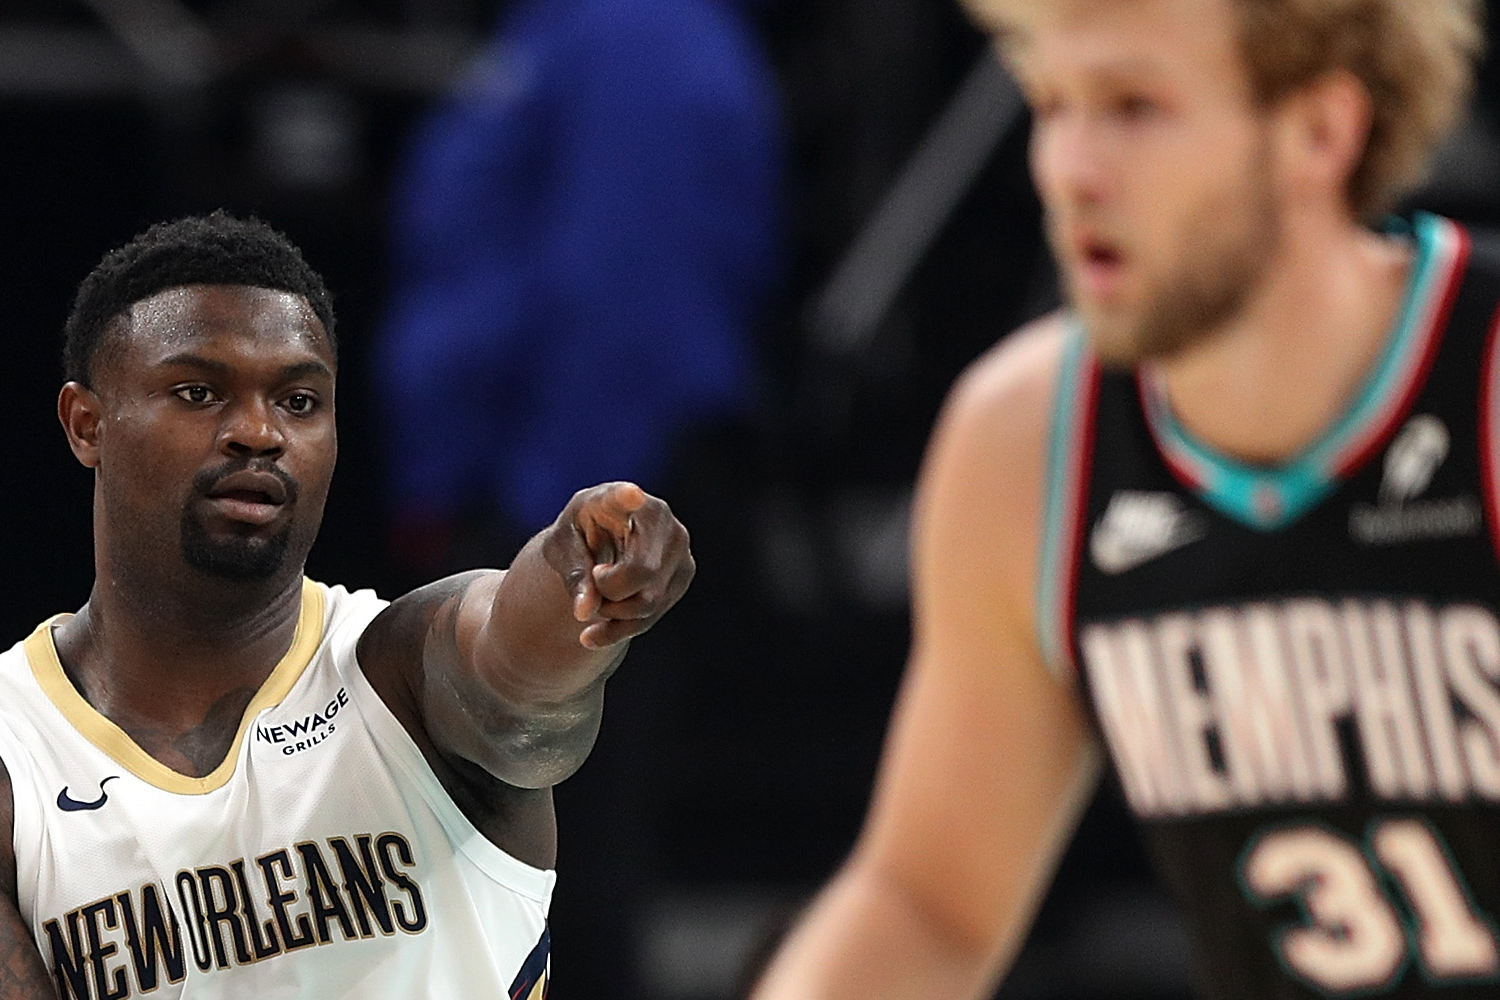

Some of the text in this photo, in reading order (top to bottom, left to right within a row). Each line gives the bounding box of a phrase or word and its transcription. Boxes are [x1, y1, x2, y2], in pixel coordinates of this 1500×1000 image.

[282, 723, 336, 756] GRILLS
[1080, 596, 1500, 820] MEMPHIS
[176, 831, 428, 973] ORLEANS
[1238, 818, 1500, 998] 31
